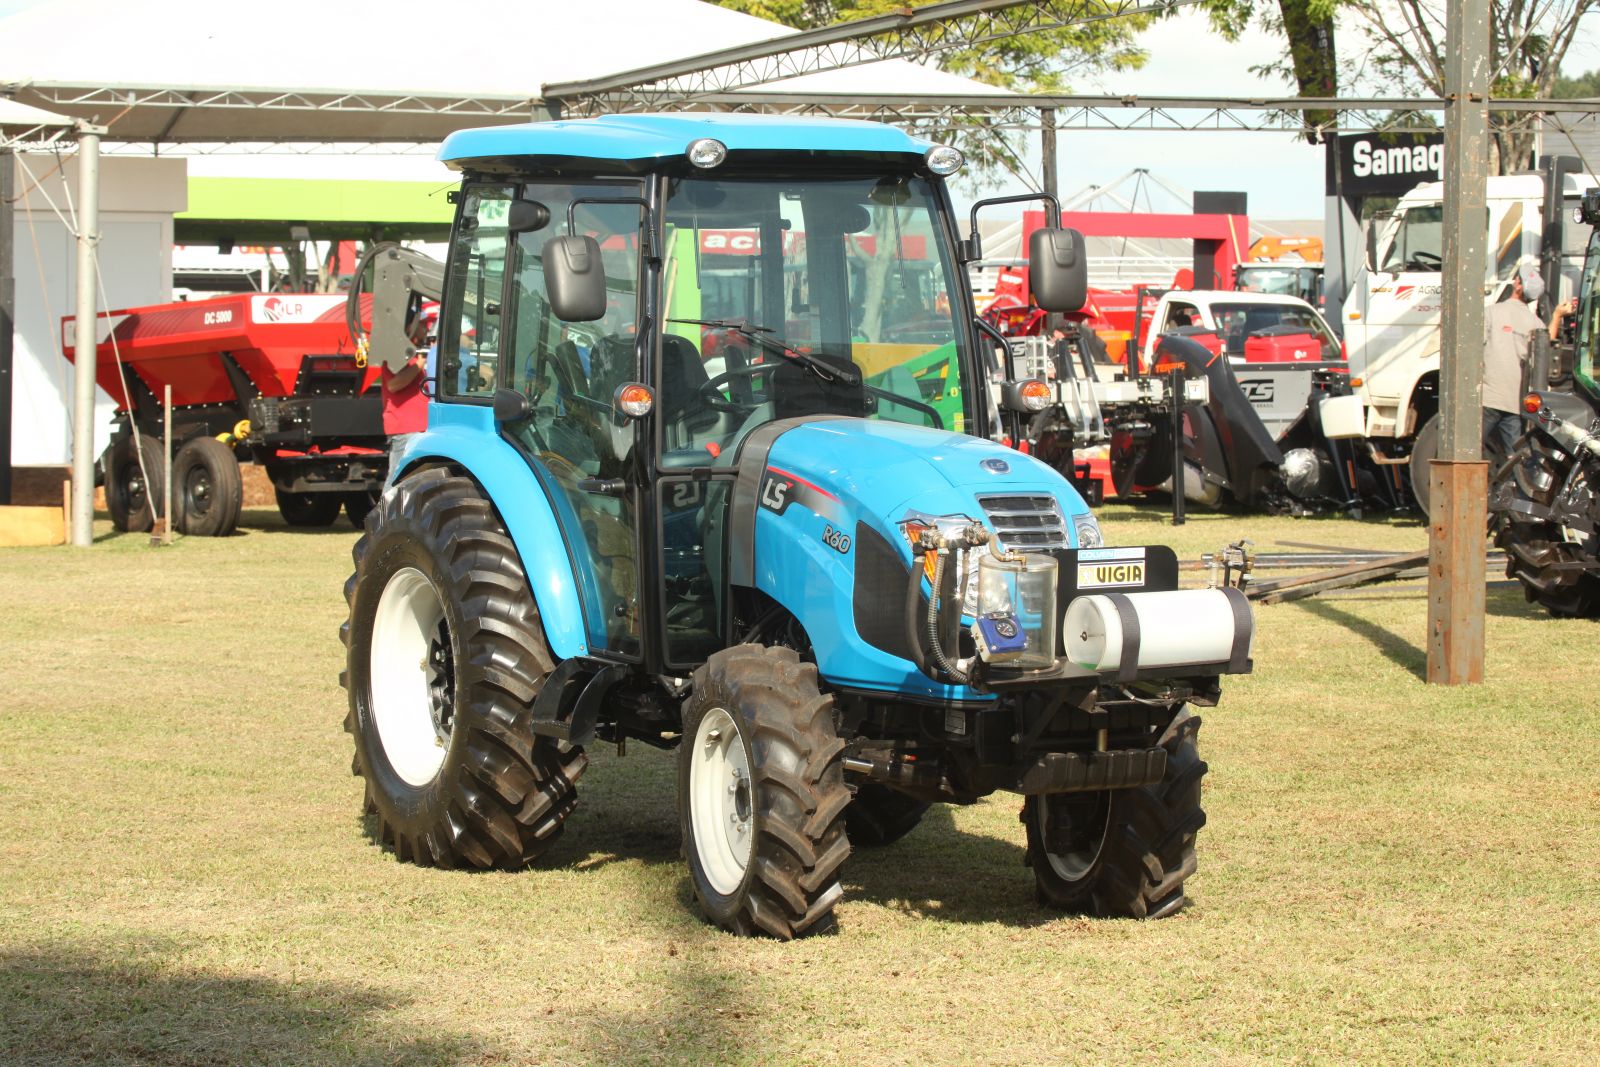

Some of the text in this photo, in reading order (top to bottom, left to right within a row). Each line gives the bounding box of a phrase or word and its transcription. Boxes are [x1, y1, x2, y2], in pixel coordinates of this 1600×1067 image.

[1353, 140, 1445, 180] Samaq
[704, 234, 761, 249] ac
[204, 312, 217, 325] DC
[763, 479, 788, 510] LS
[822, 524, 851, 554] R60
[1096, 565, 1142, 583] VIGIA
